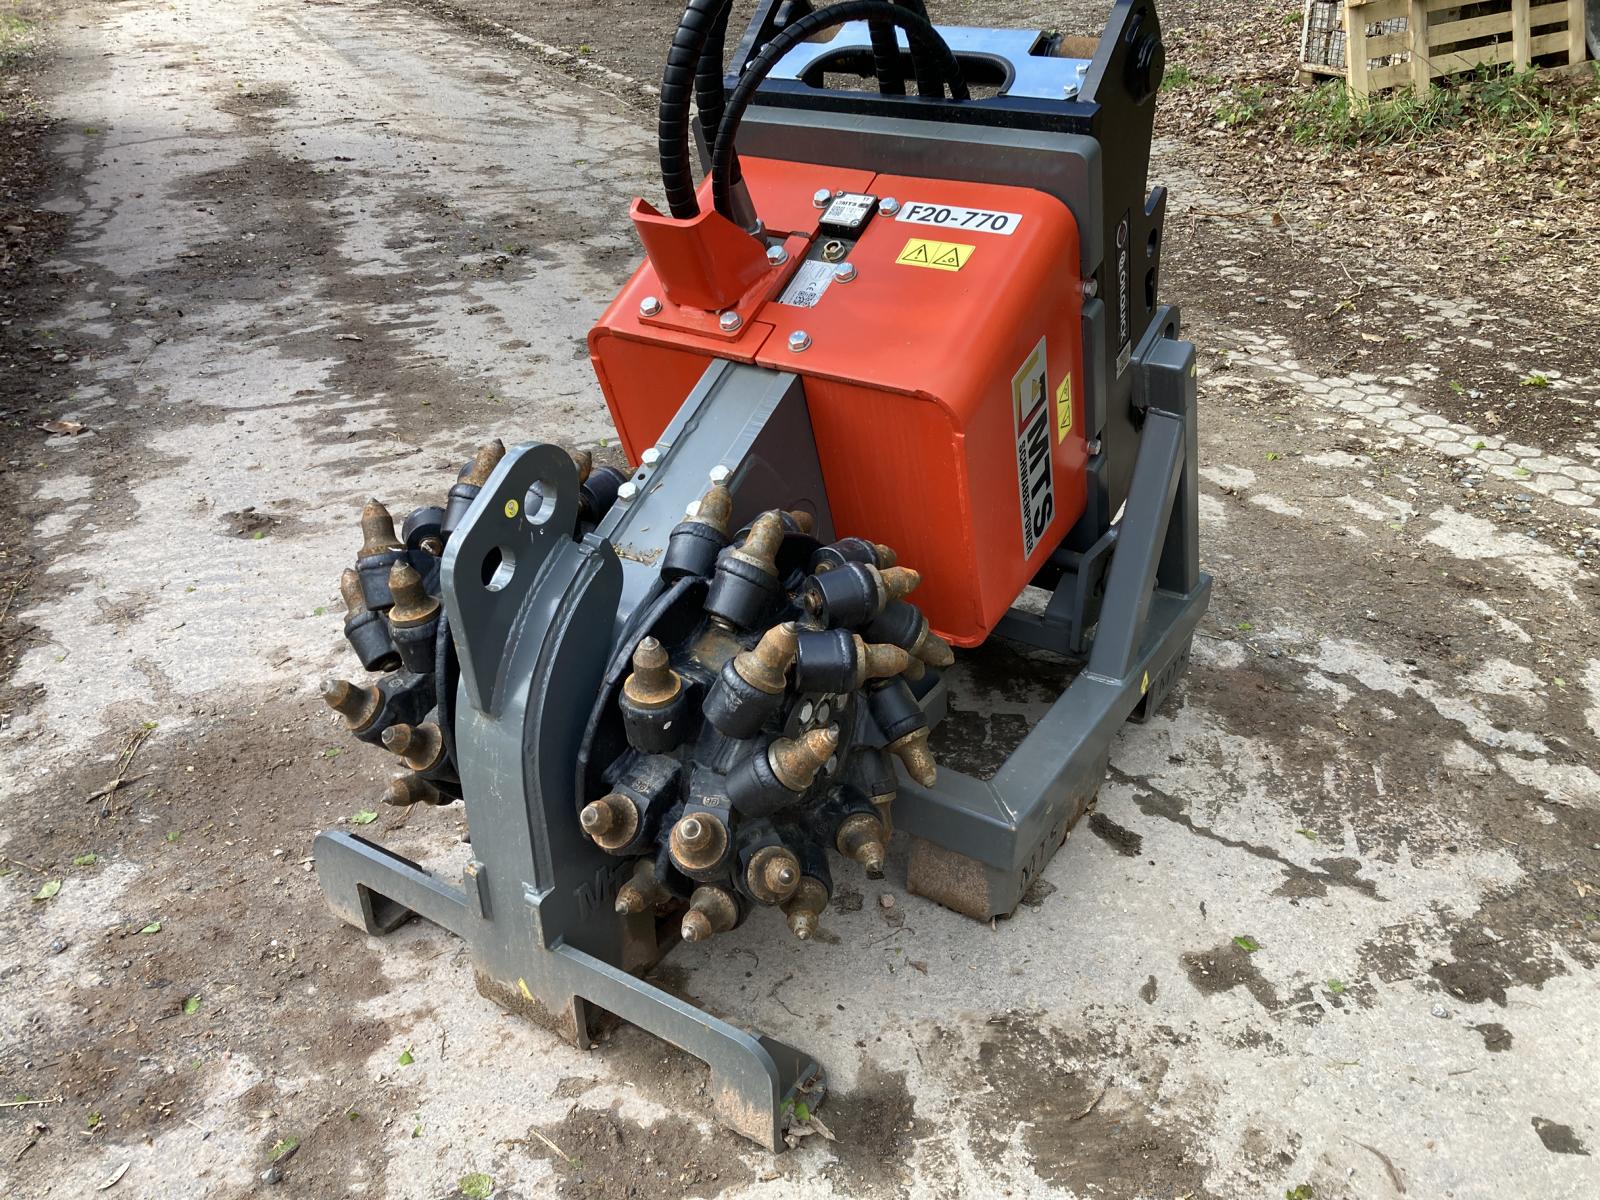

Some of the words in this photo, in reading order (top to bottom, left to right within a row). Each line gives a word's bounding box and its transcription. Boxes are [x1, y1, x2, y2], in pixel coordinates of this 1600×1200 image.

[905, 205, 1009, 231] F20-770
[1018, 440, 1034, 555] SCHWABENPOWER
[1027, 407, 1053, 539] MTS
